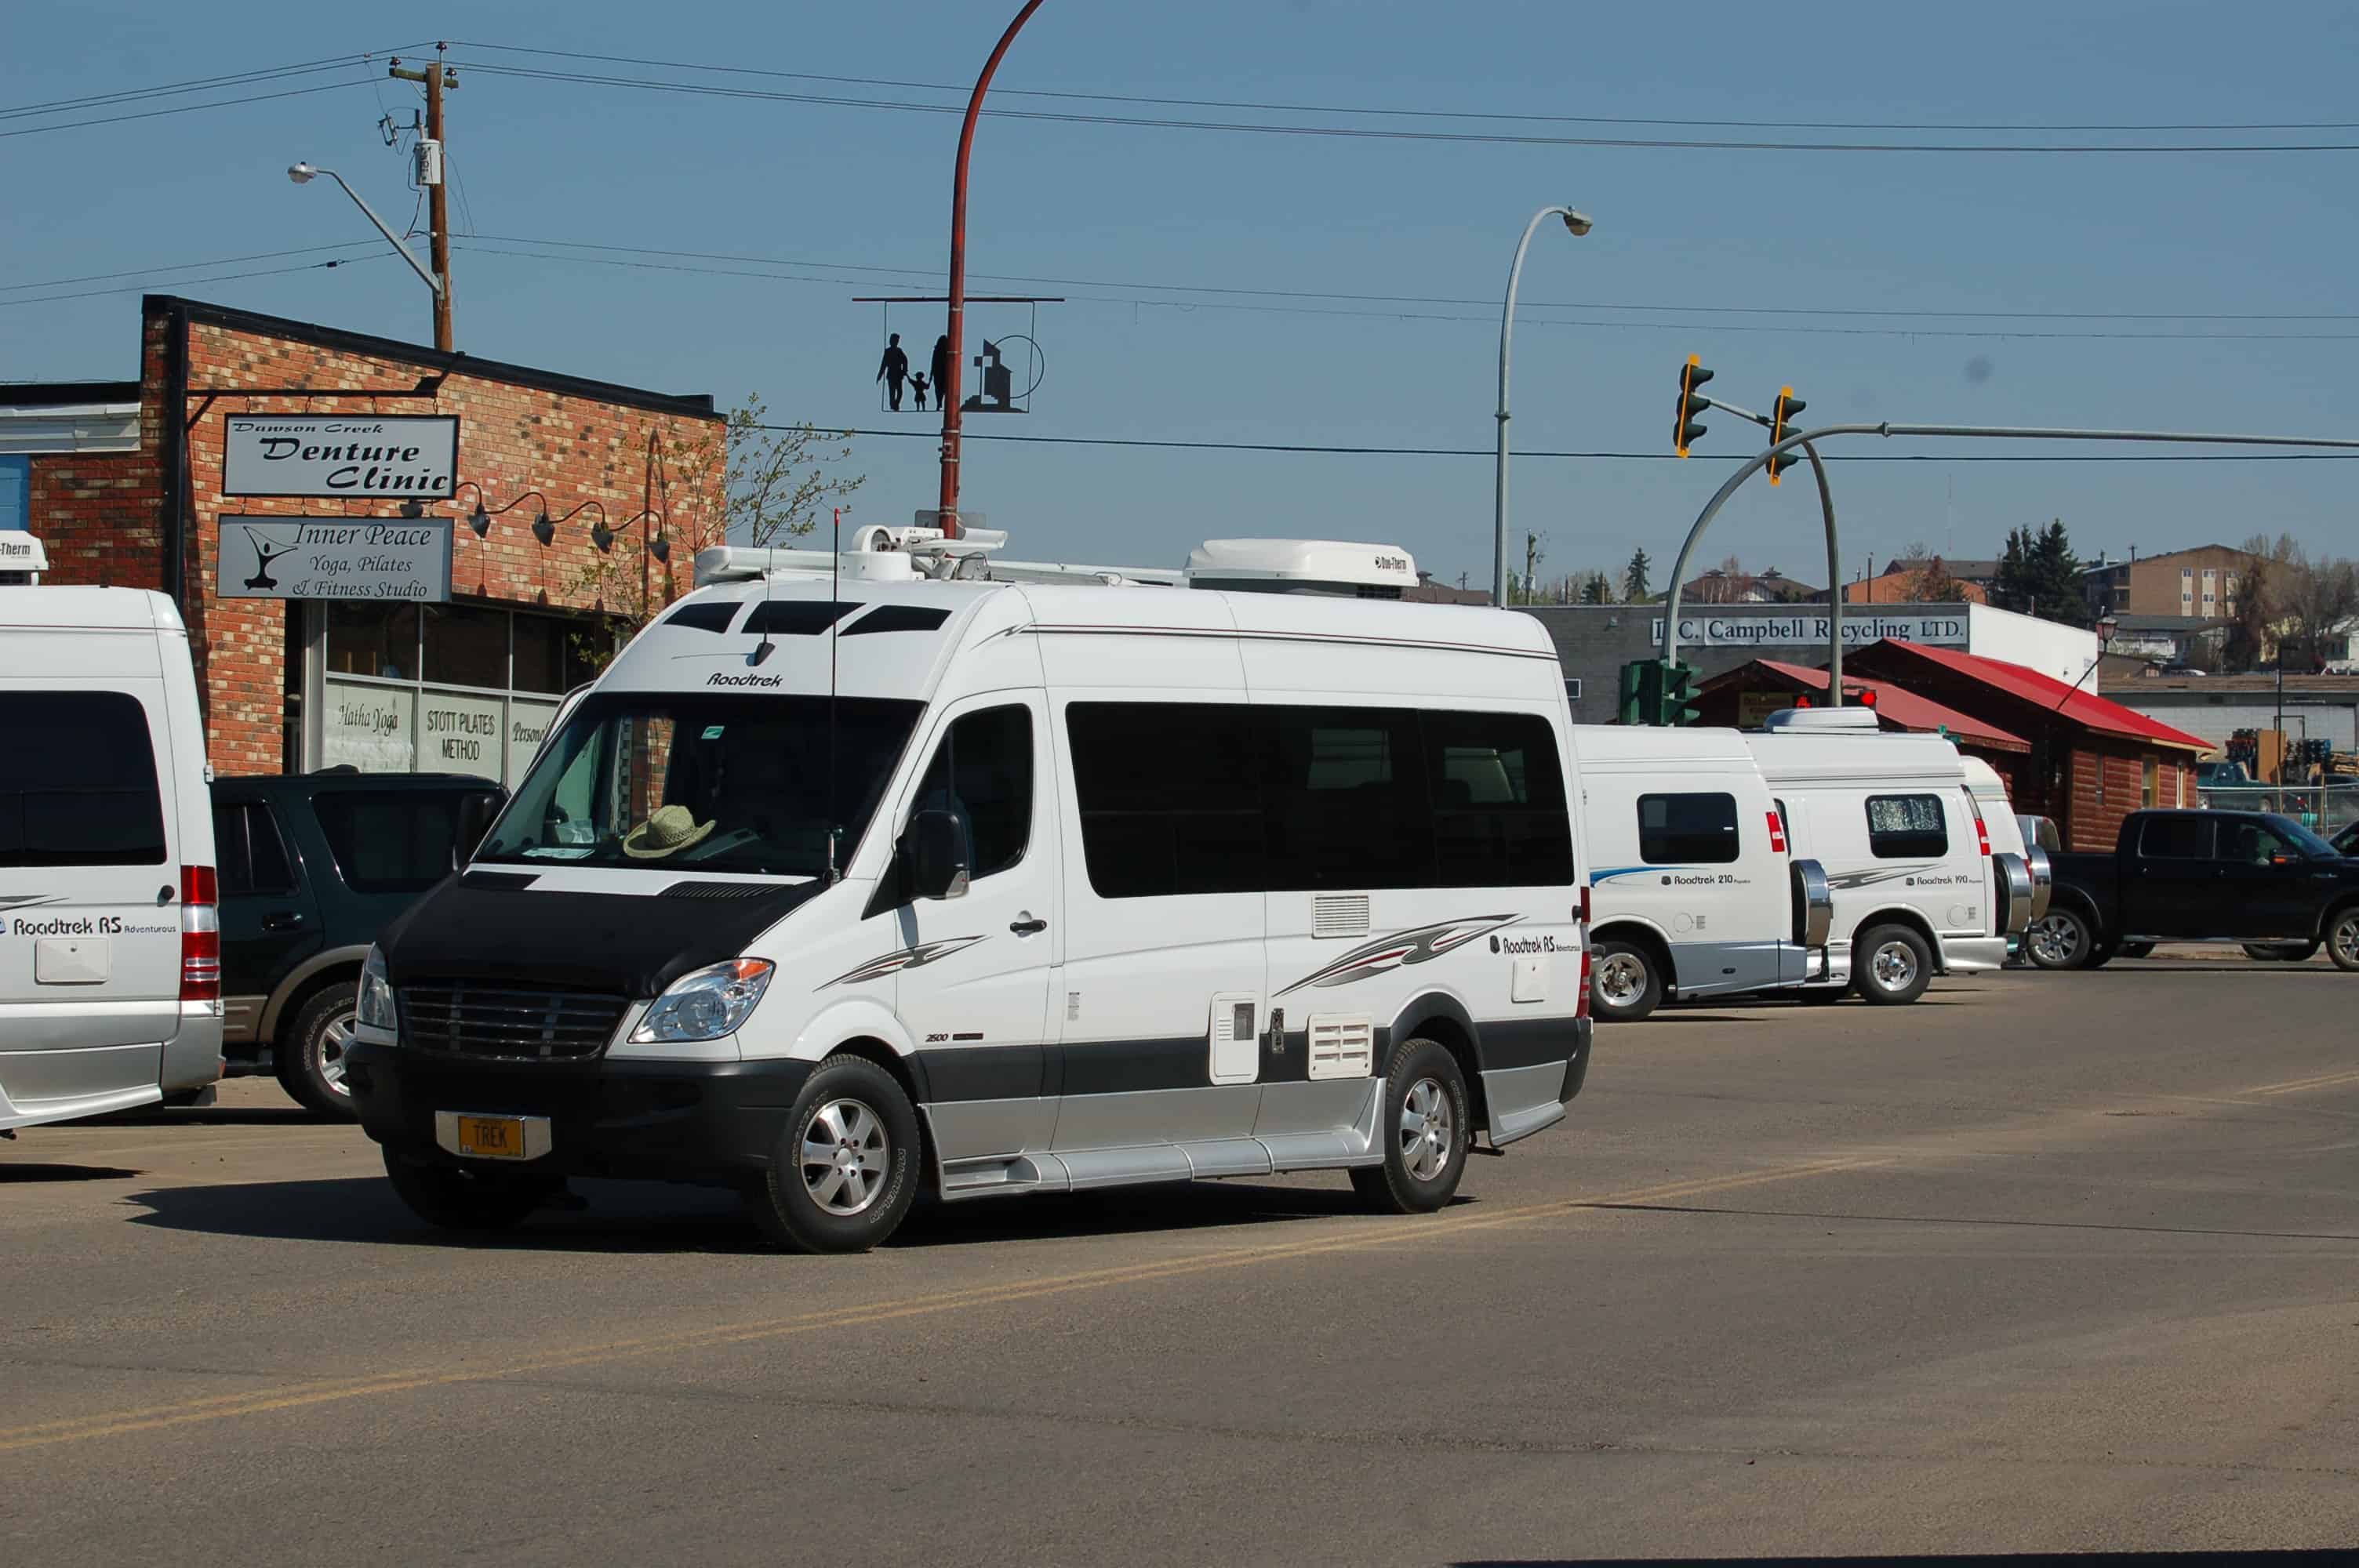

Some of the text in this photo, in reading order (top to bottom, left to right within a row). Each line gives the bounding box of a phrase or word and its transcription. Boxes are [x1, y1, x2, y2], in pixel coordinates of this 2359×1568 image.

[233, 423, 383, 434] Dawson Creek
[259, 437, 420, 462] Denture
[325, 466, 449, 490] Clinic
[293, 522, 431, 546] Inner Peace
[310, 554, 413, 576] Yoga, Pilates
[293, 579, 427, 597] & Fitness Studio
[1708, 619, 1803, 644] Campbell
[1814, 618, 1910, 642] Rcycling
[1920, 621, 1963, 638] LTD.
[707, 673, 783, 687] Roadtrek
[339, 702, 398, 737] Hatha Yoga
[427, 710, 495, 735] STOTT PILATES
[442, 739, 480, 760] METHOD
[1674, 875, 1715, 885] Roadtrek
[1718, 874, 1733, 884] 210
[1917, 876, 1953, 885] Roadtrek
[1955, 875, 1968, 884] 190
[14, 916, 176, 935] Roadtrek RS Adventurous
[1503, 936, 1543, 954] Roadtrek
[1543, 935, 1555, 953] RS
[473, 1123, 507, 1148] TREK
